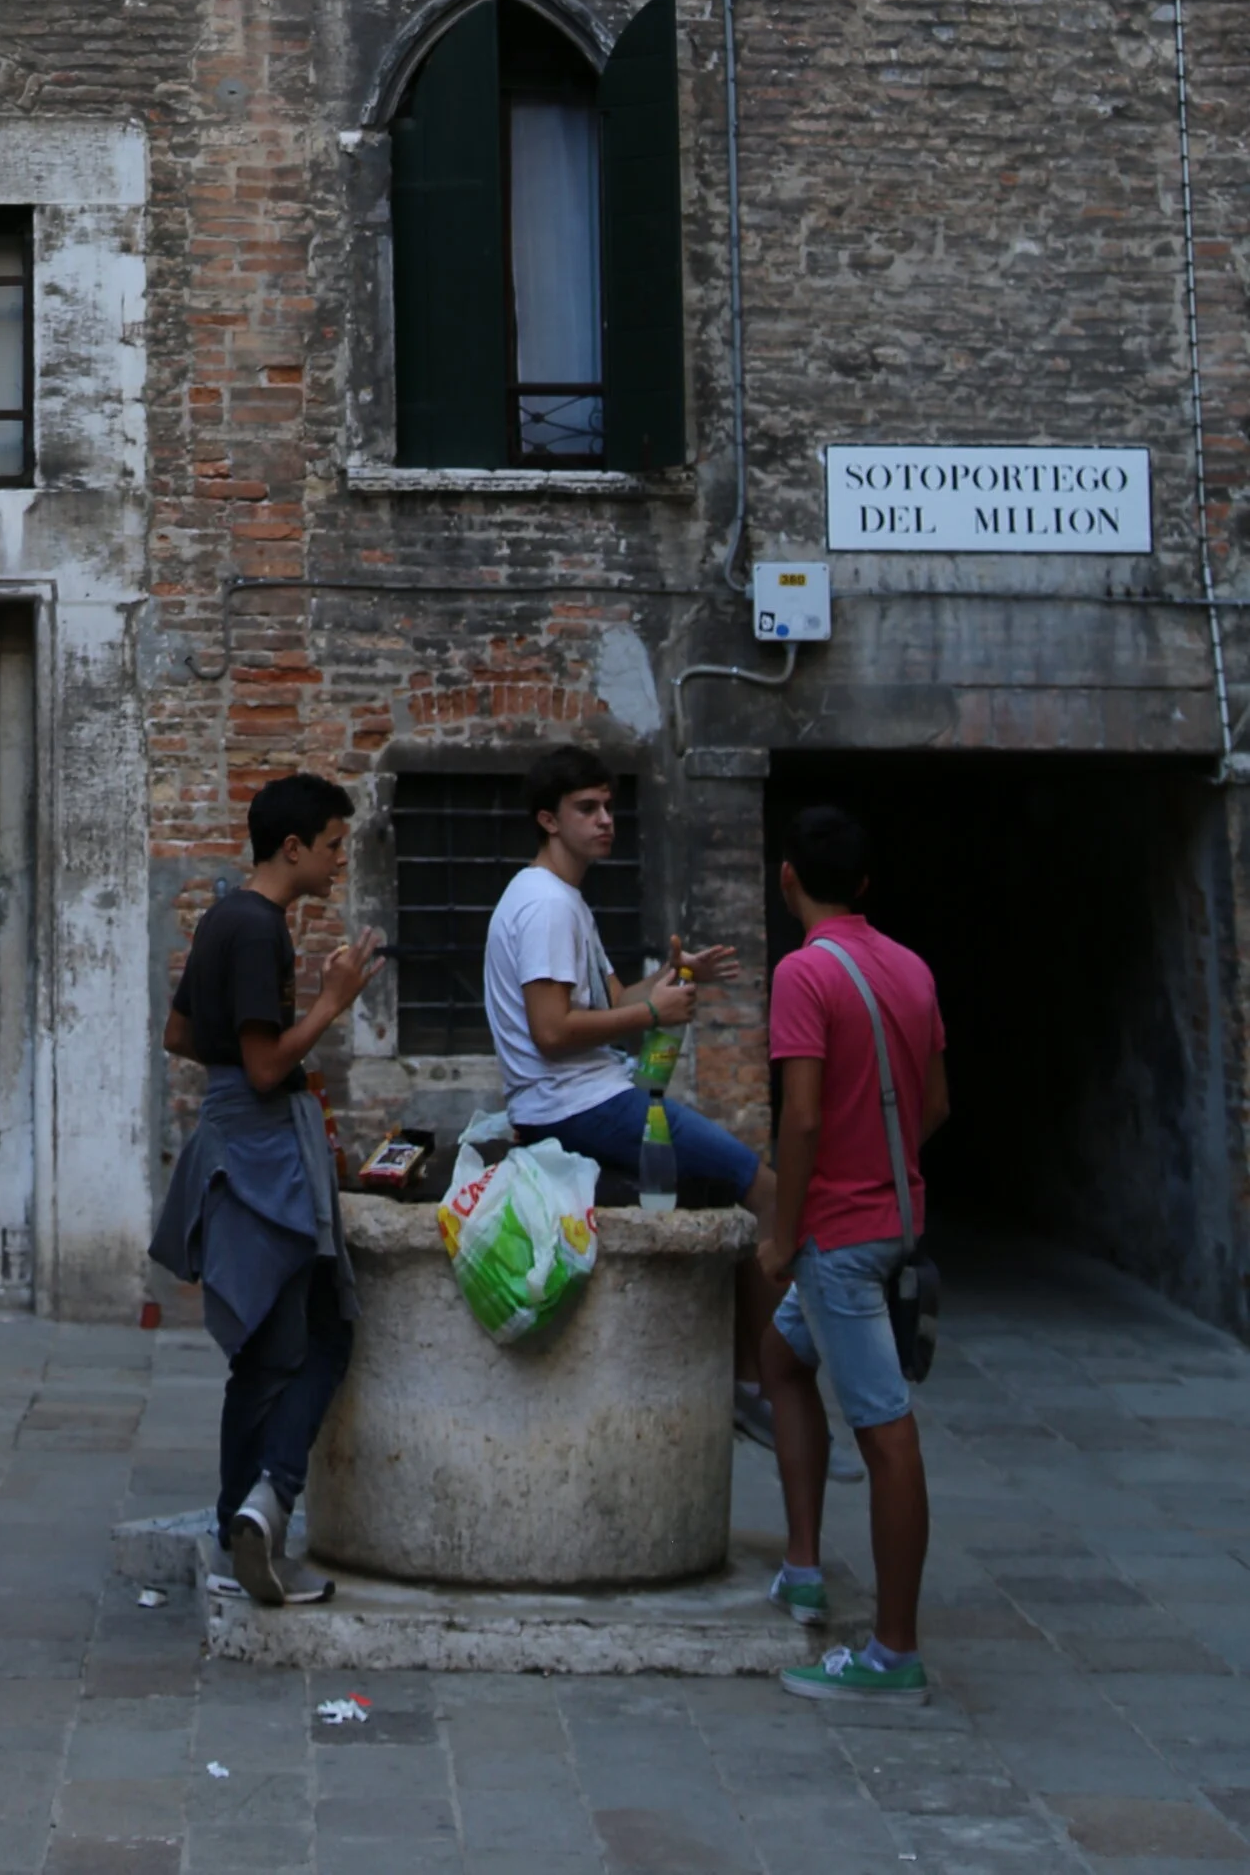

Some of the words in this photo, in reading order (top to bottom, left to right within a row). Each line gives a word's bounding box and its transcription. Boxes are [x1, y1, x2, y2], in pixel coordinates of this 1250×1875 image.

[845, 464, 1128, 493] SOTOPORTEGO
[860, 505, 937, 534] DEL
[975, 506, 1120, 535] MILION
